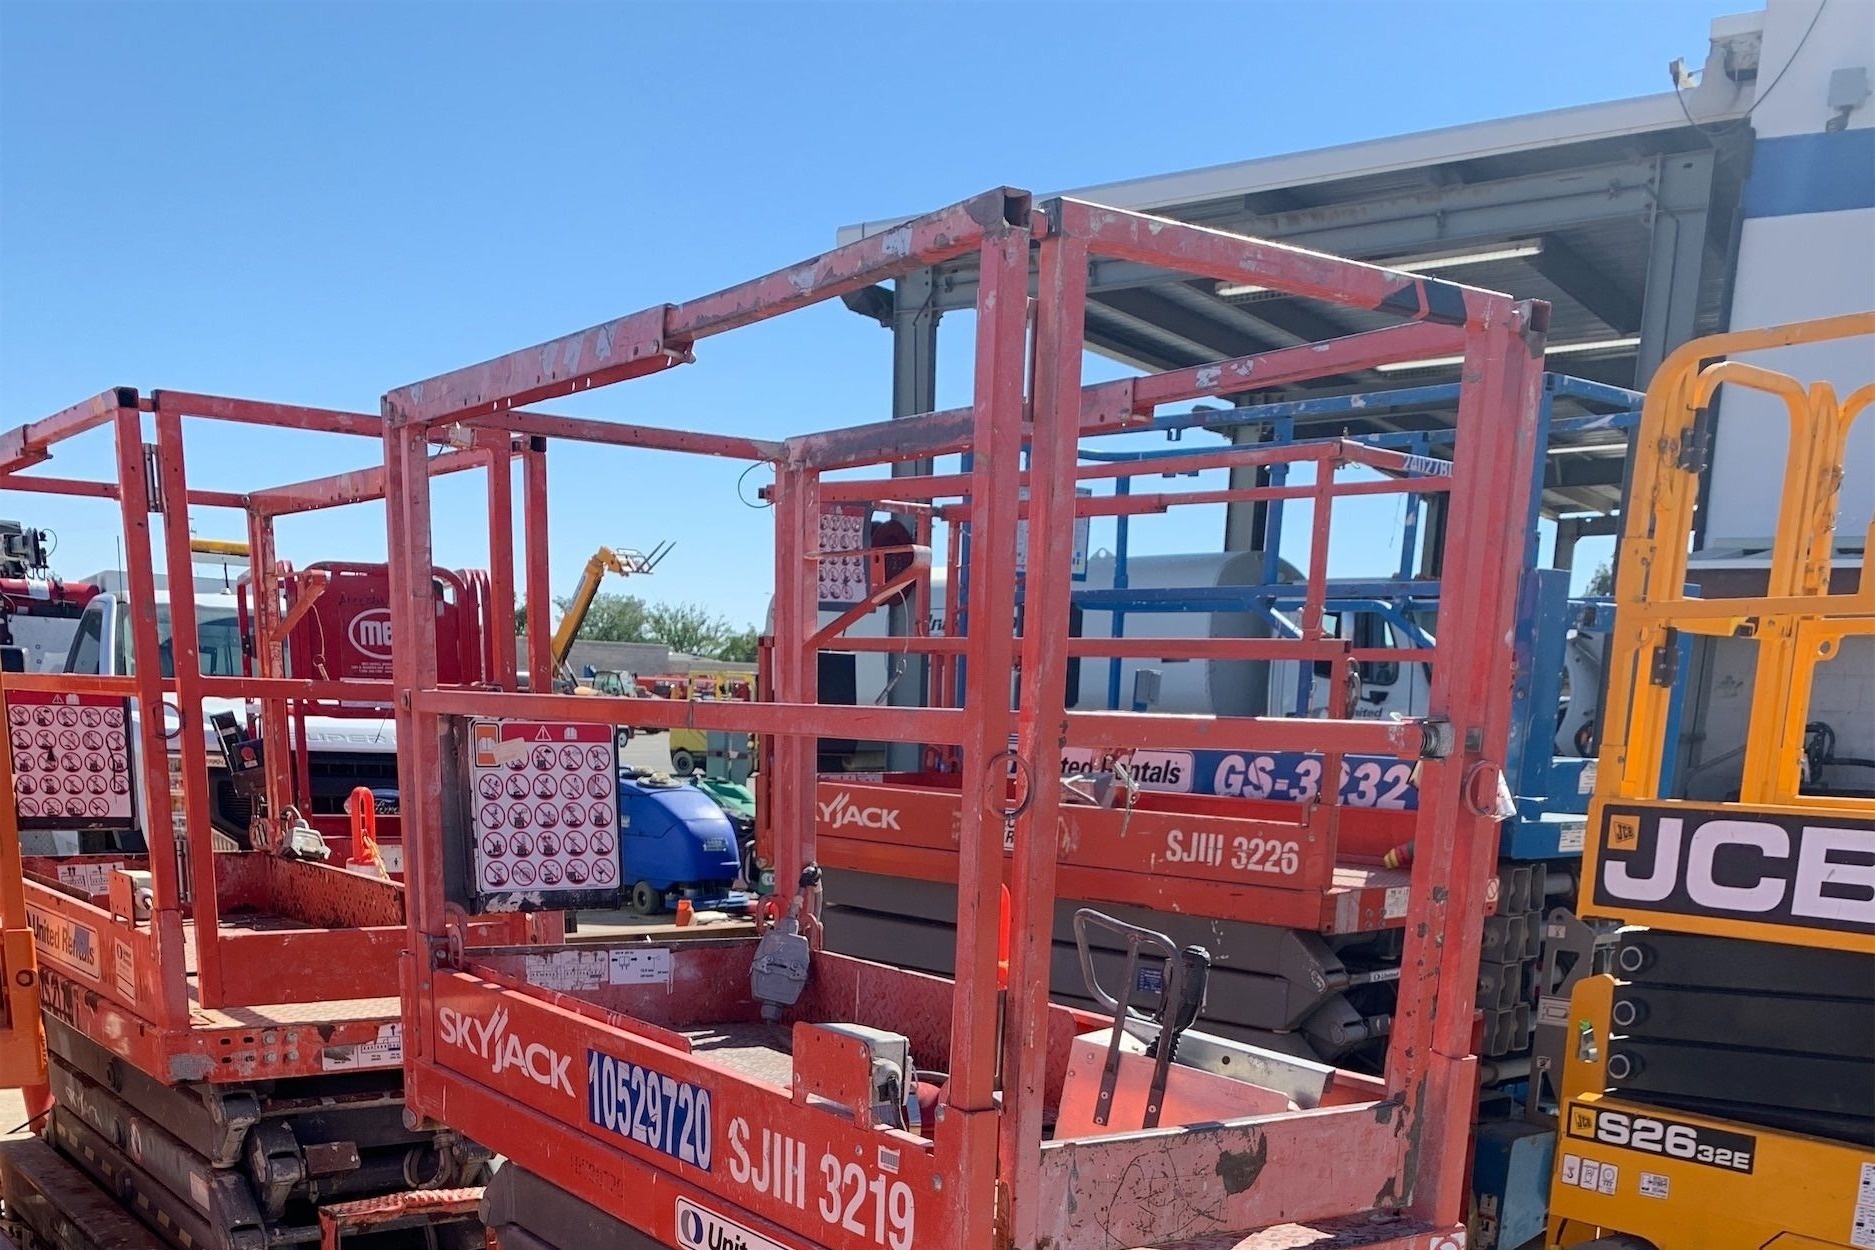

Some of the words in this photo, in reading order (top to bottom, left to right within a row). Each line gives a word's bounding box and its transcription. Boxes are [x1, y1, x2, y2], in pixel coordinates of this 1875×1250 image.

[360, 620, 393, 646] ME
[815, 791, 902, 831] YJACK
[1230, 836, 1299, 875] 3226
[1603, 817, 1875, 924] JCB
[33, 914, 60, 948] United
[439, 1002, 576, 1098] SKYJACK
[588, 1051, 712, 1171] 10529720
